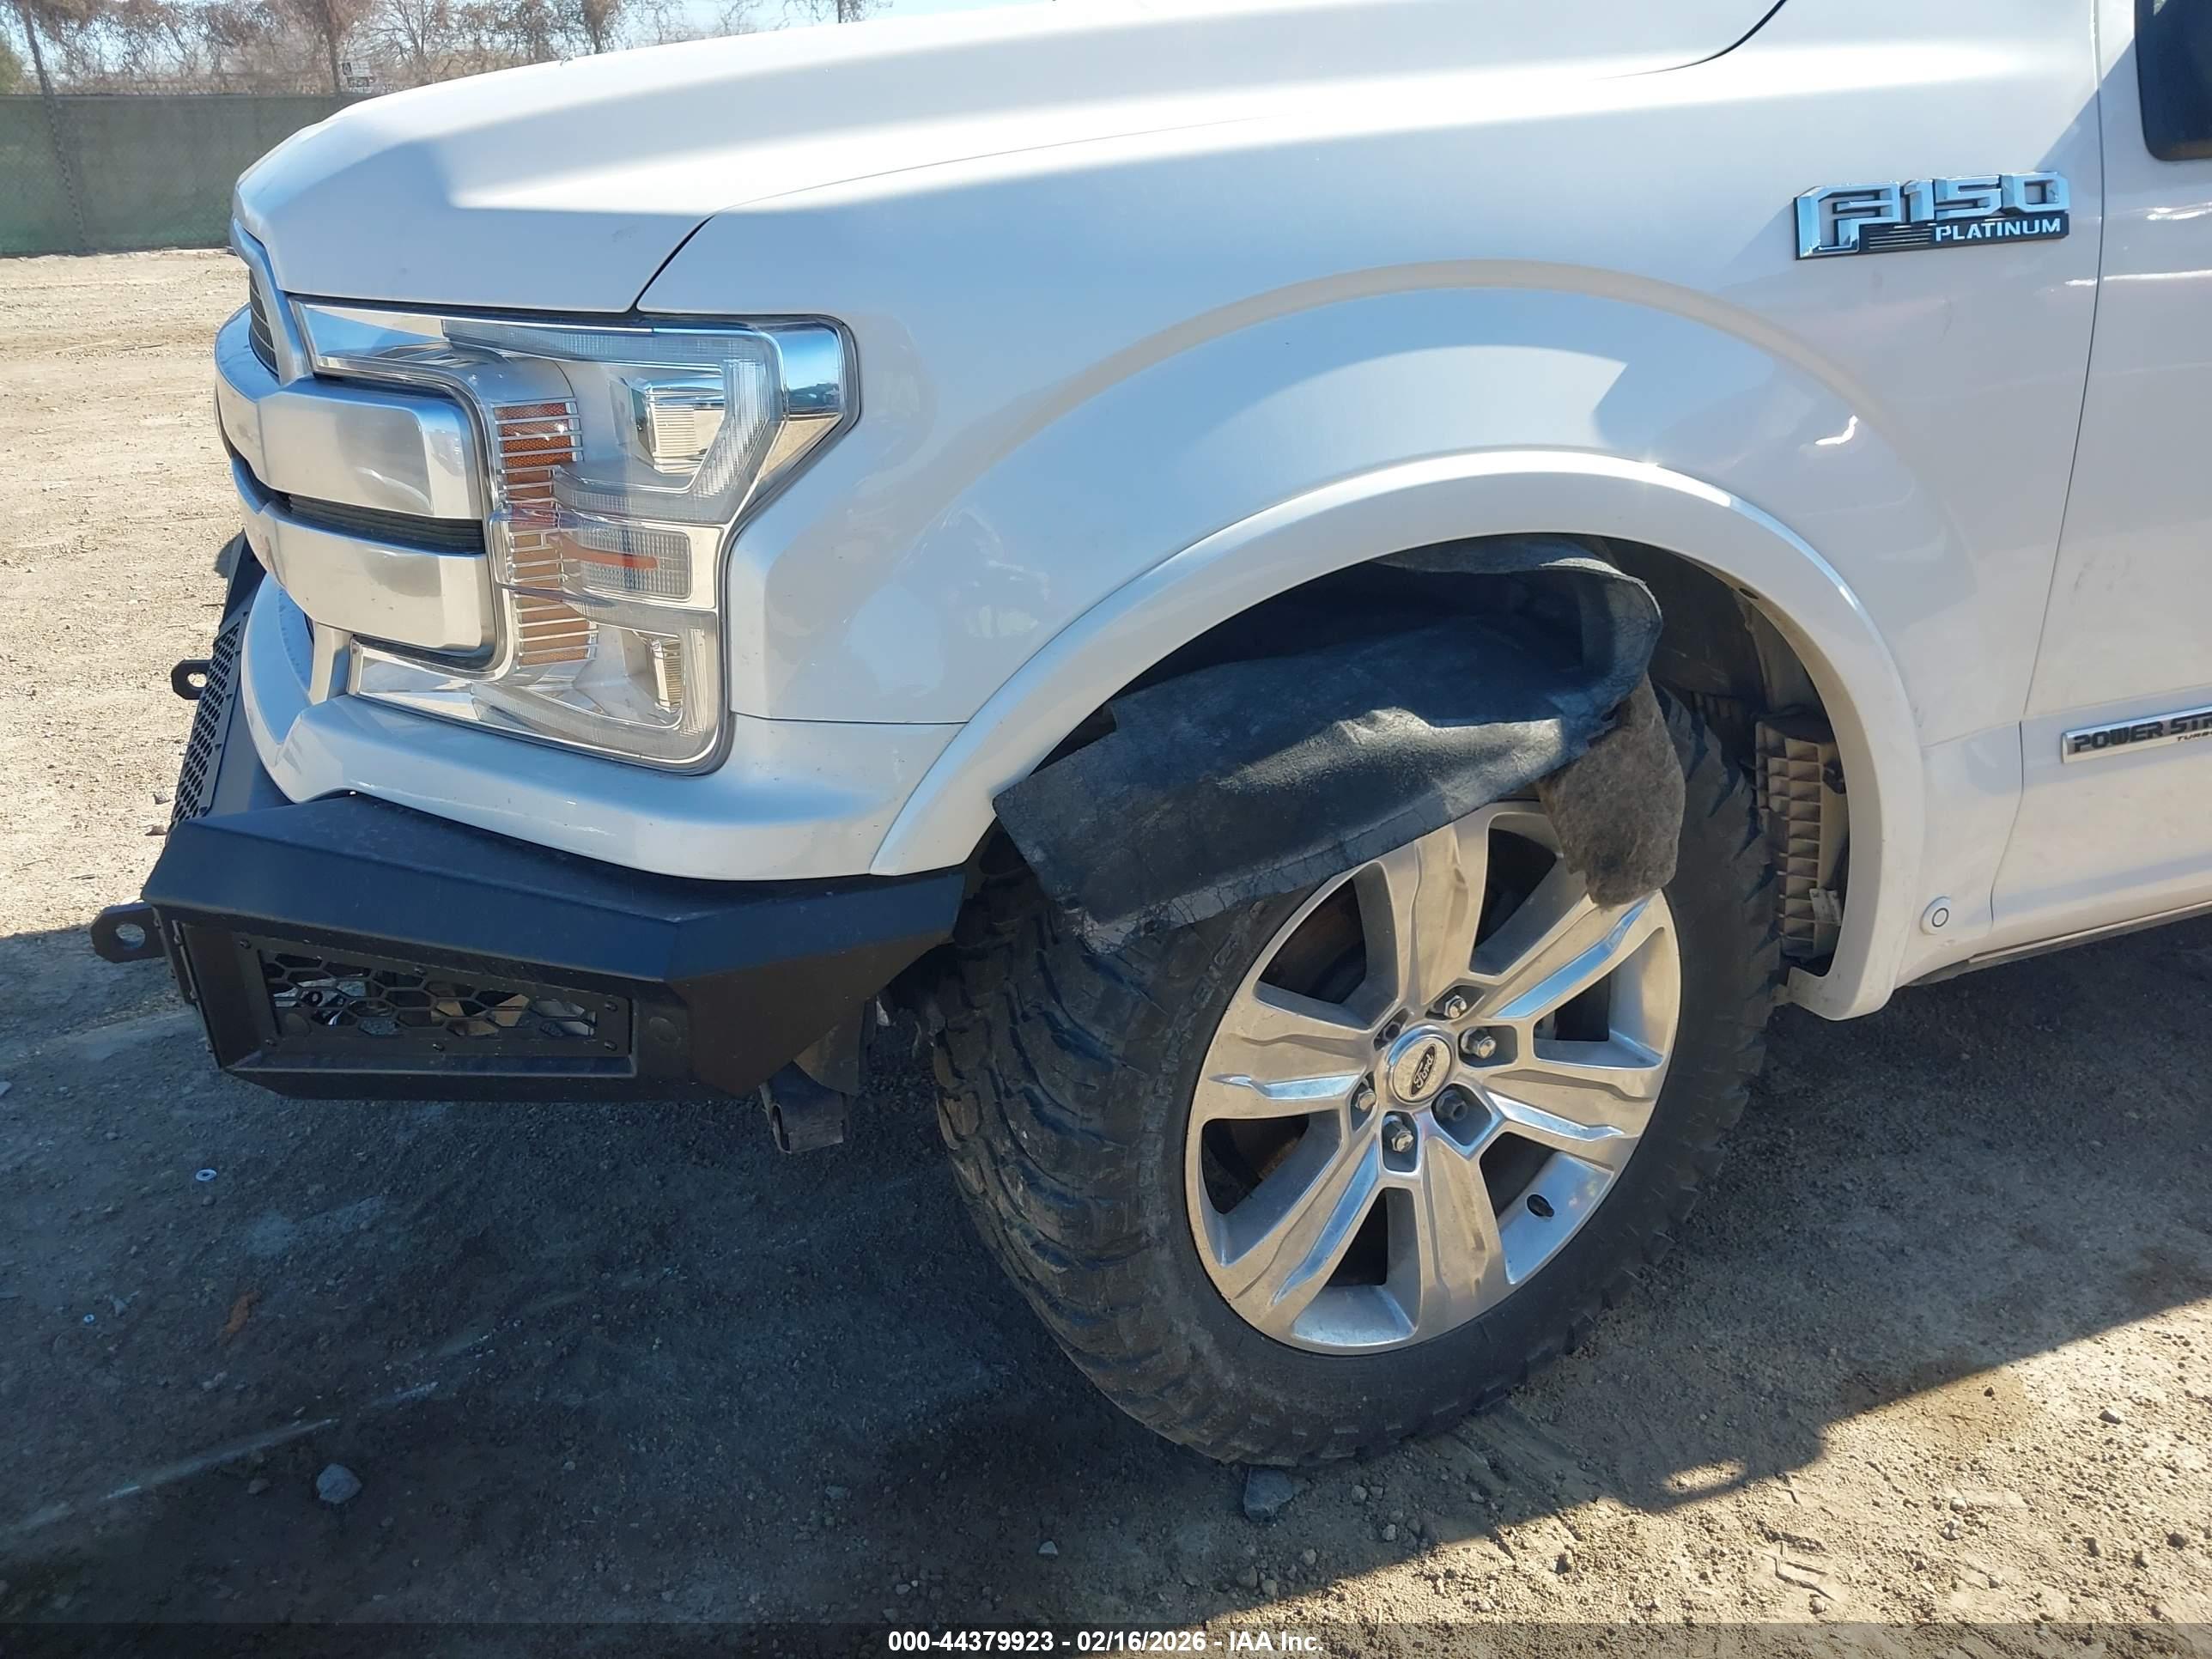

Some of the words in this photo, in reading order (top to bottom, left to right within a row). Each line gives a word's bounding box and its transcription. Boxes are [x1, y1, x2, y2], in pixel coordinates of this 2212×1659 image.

[1935, 216, 2062, 243] PLATINUM
[2073, 720, 2164, 754] POWER
[1413, 1051, 1435, 1090] Ford
